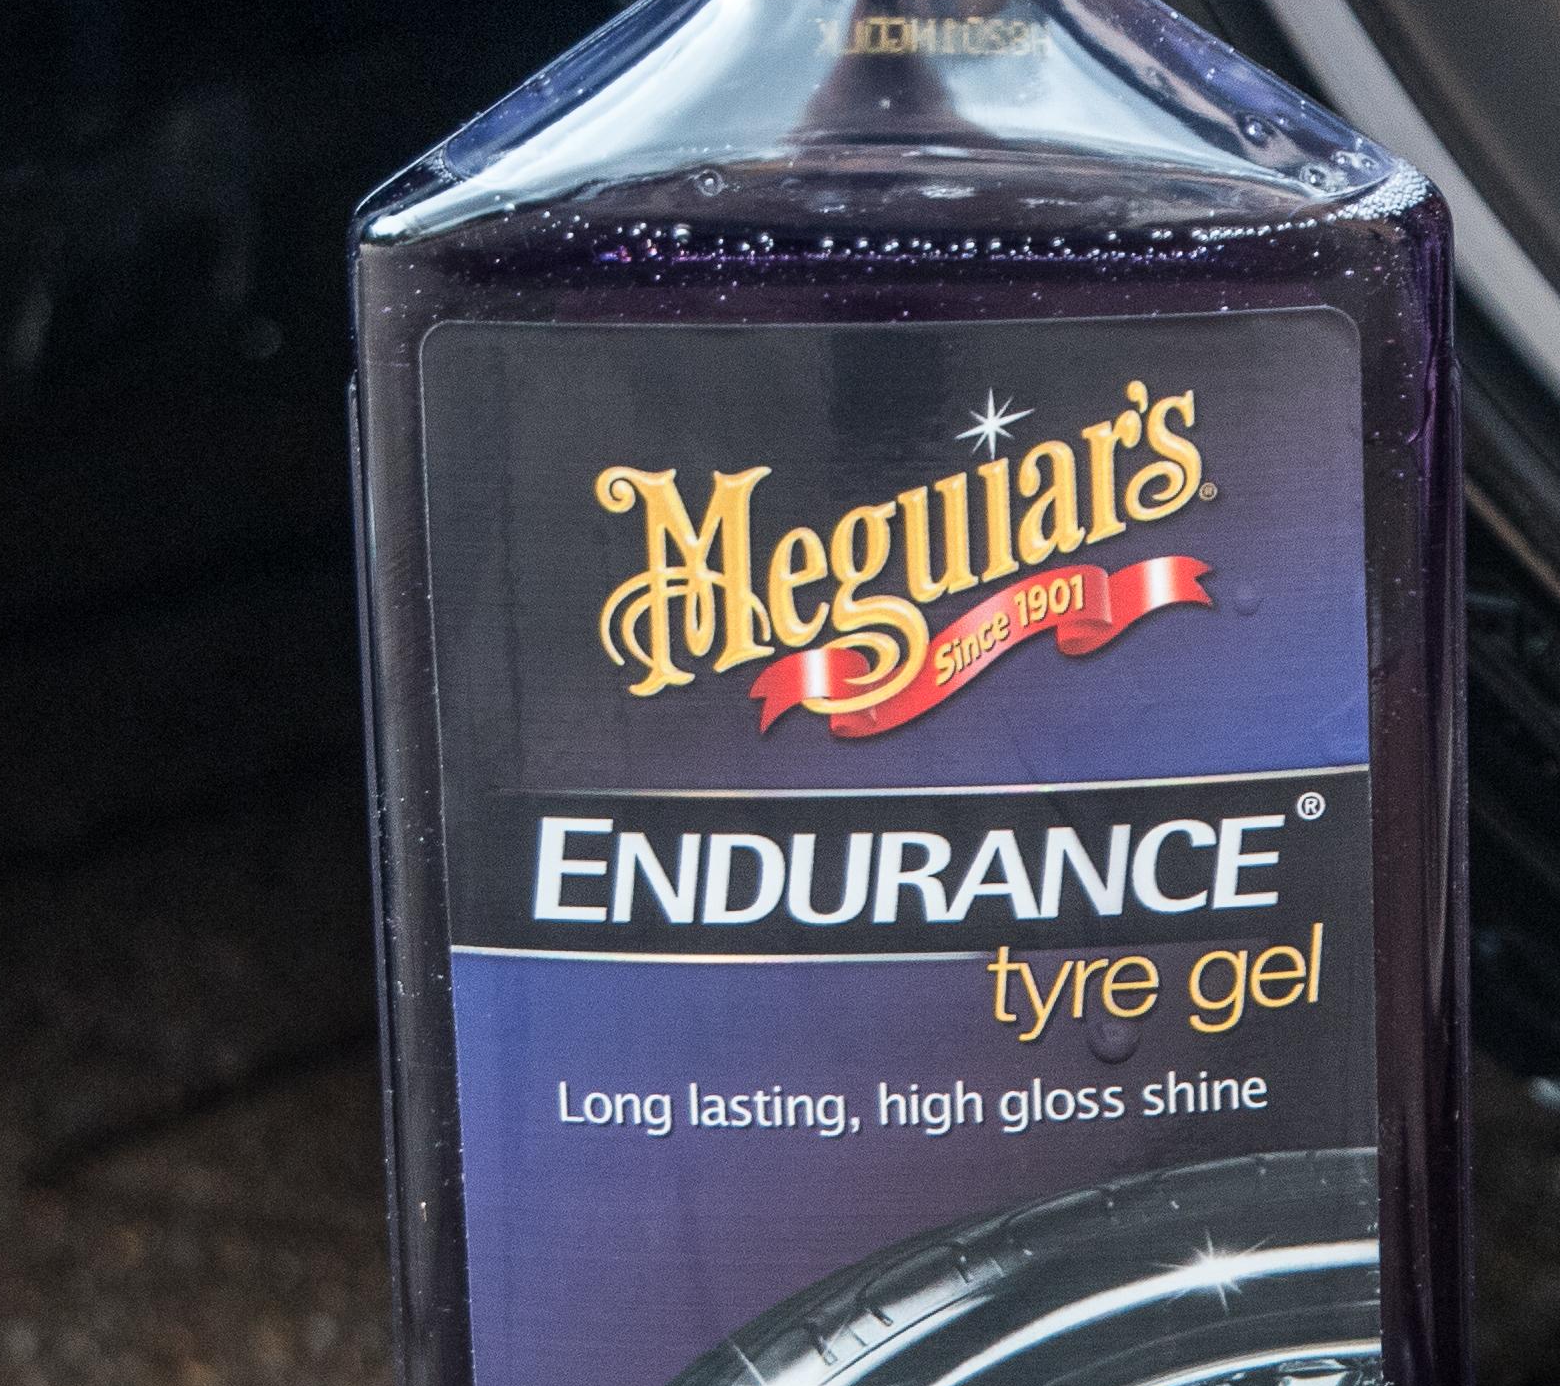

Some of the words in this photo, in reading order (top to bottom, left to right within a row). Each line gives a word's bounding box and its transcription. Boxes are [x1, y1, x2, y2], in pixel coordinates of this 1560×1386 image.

[595, 379, 1204, 715] Meguiar's
[934, 612, 1010, 686] Since
[1013, 573, 1084, 629] 1901
[986, 943, 1160, 1042] tyre
[1188, 922, 1325, 1035] gel
[558, 1079, 673, 1137] Long
[688, 1081, 862, 1137] lasting,
[878, 1079, 984, 1134] high
[999, 1076, 1126, 1131] gloss
[1141, 1069, 1269, 1116] shine
